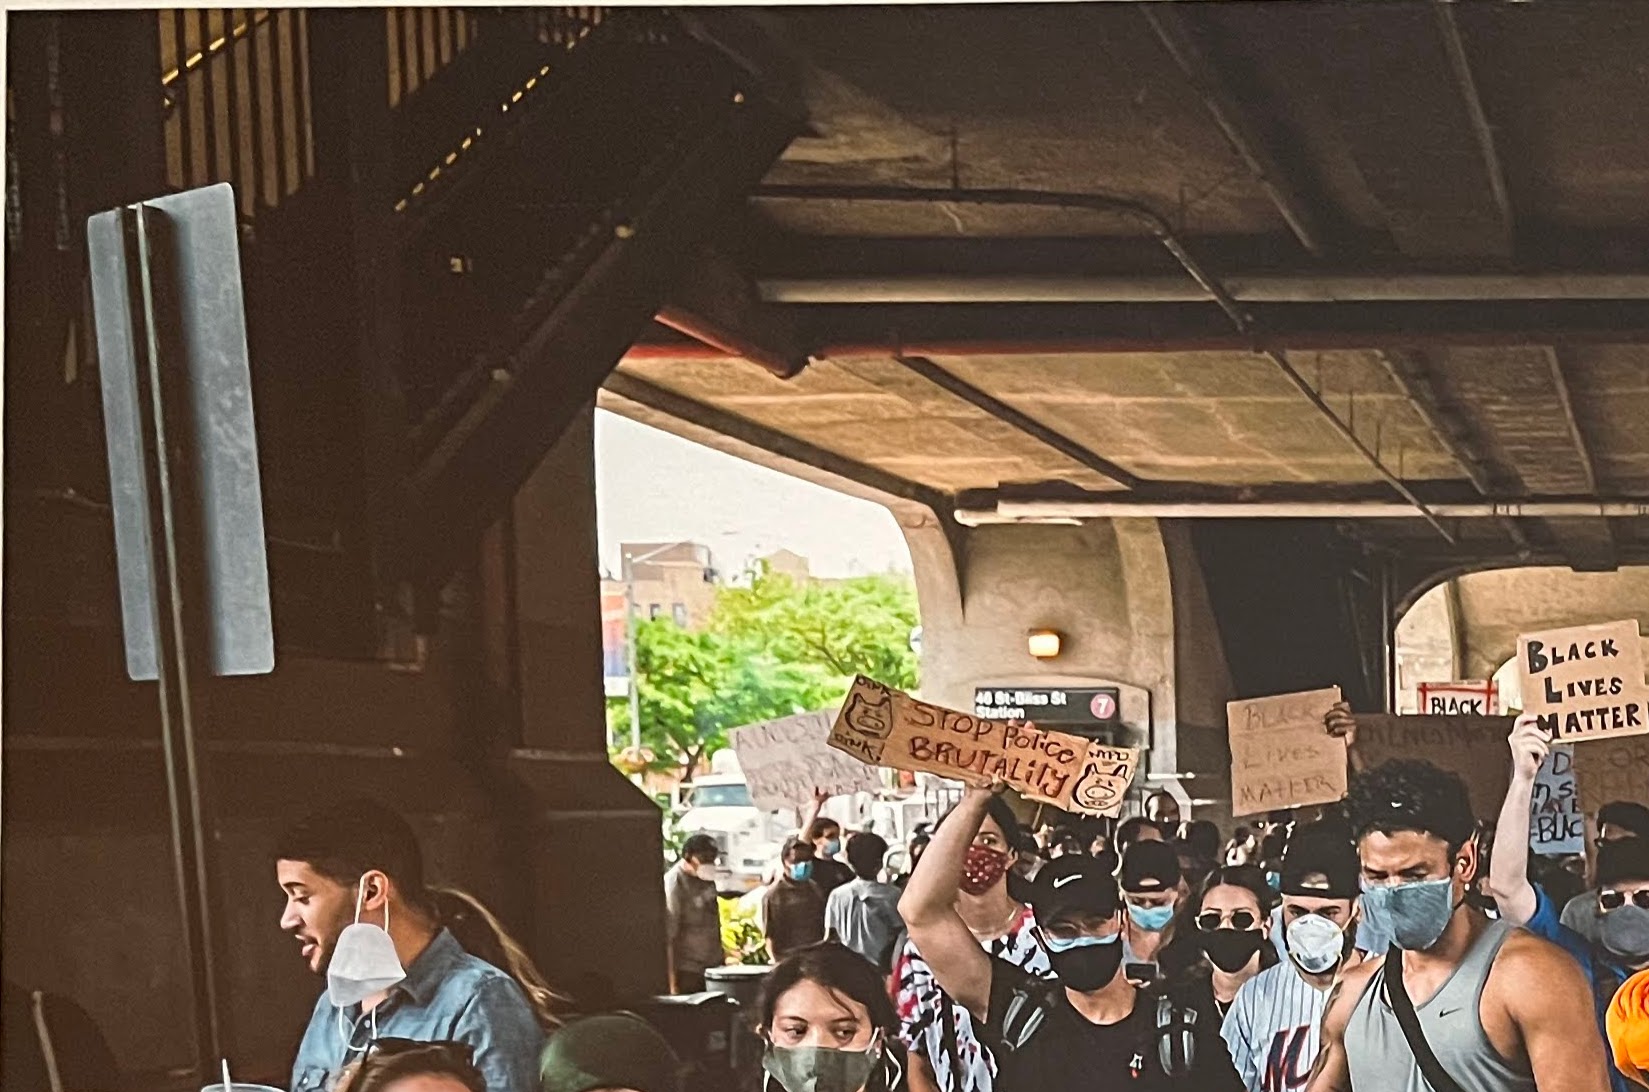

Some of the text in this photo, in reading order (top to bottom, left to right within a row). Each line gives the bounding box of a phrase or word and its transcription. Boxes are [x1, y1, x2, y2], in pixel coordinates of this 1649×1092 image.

[1527, 639, 1619, 674] BLACK
[1050, 691, 1066, 705] St
[1544, 676, 1623, 703] LIVES
[976, 706, 1025, 719] Station
[1097, 699, 1108, 713] 7
[1431, 697, 1484, 716] BLACK
[904, 704, 993, 741] STOP
[1536, 703, 1641, 739] MATTER
